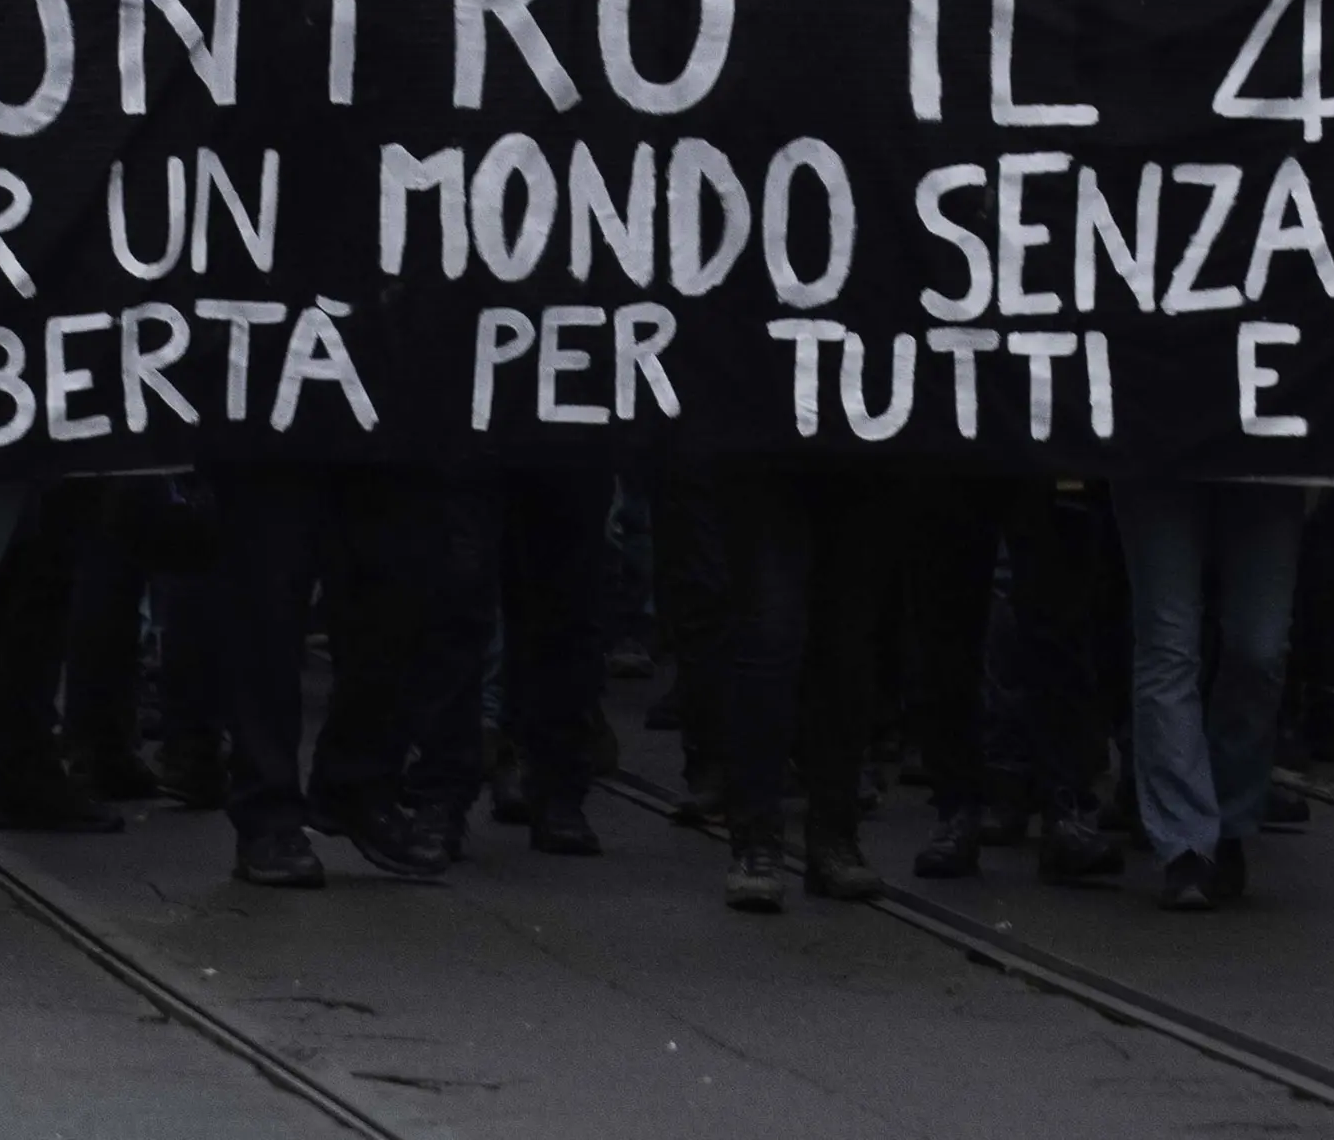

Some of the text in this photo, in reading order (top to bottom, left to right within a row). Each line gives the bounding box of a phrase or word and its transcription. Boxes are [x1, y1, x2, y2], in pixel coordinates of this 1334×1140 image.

[108, 148, 279, 280] UN
[380, 133, 855, 309] MONDO
[472, 302, 680, 431] PER
[766, 318, 1113, 441] TUTTI
[1237, 321, 1307, 437] E
